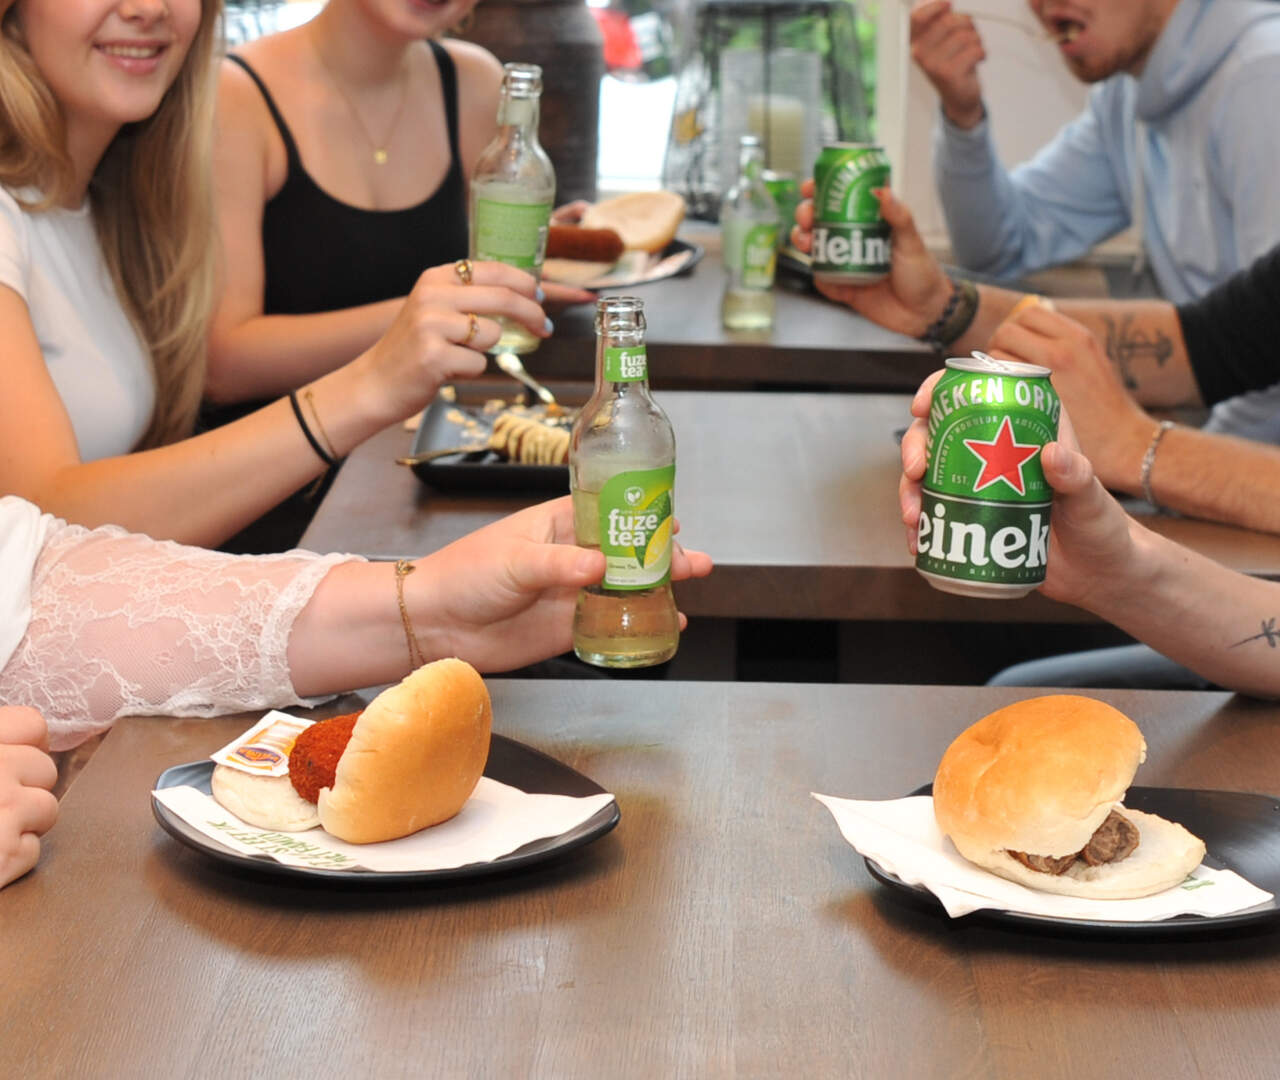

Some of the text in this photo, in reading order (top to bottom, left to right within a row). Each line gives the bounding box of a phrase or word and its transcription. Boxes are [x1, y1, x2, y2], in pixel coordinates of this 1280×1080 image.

[620, 366, 644, 378] tea
[608, 508, 658, 532] fuze
[608, 530, 646, 547] tea
